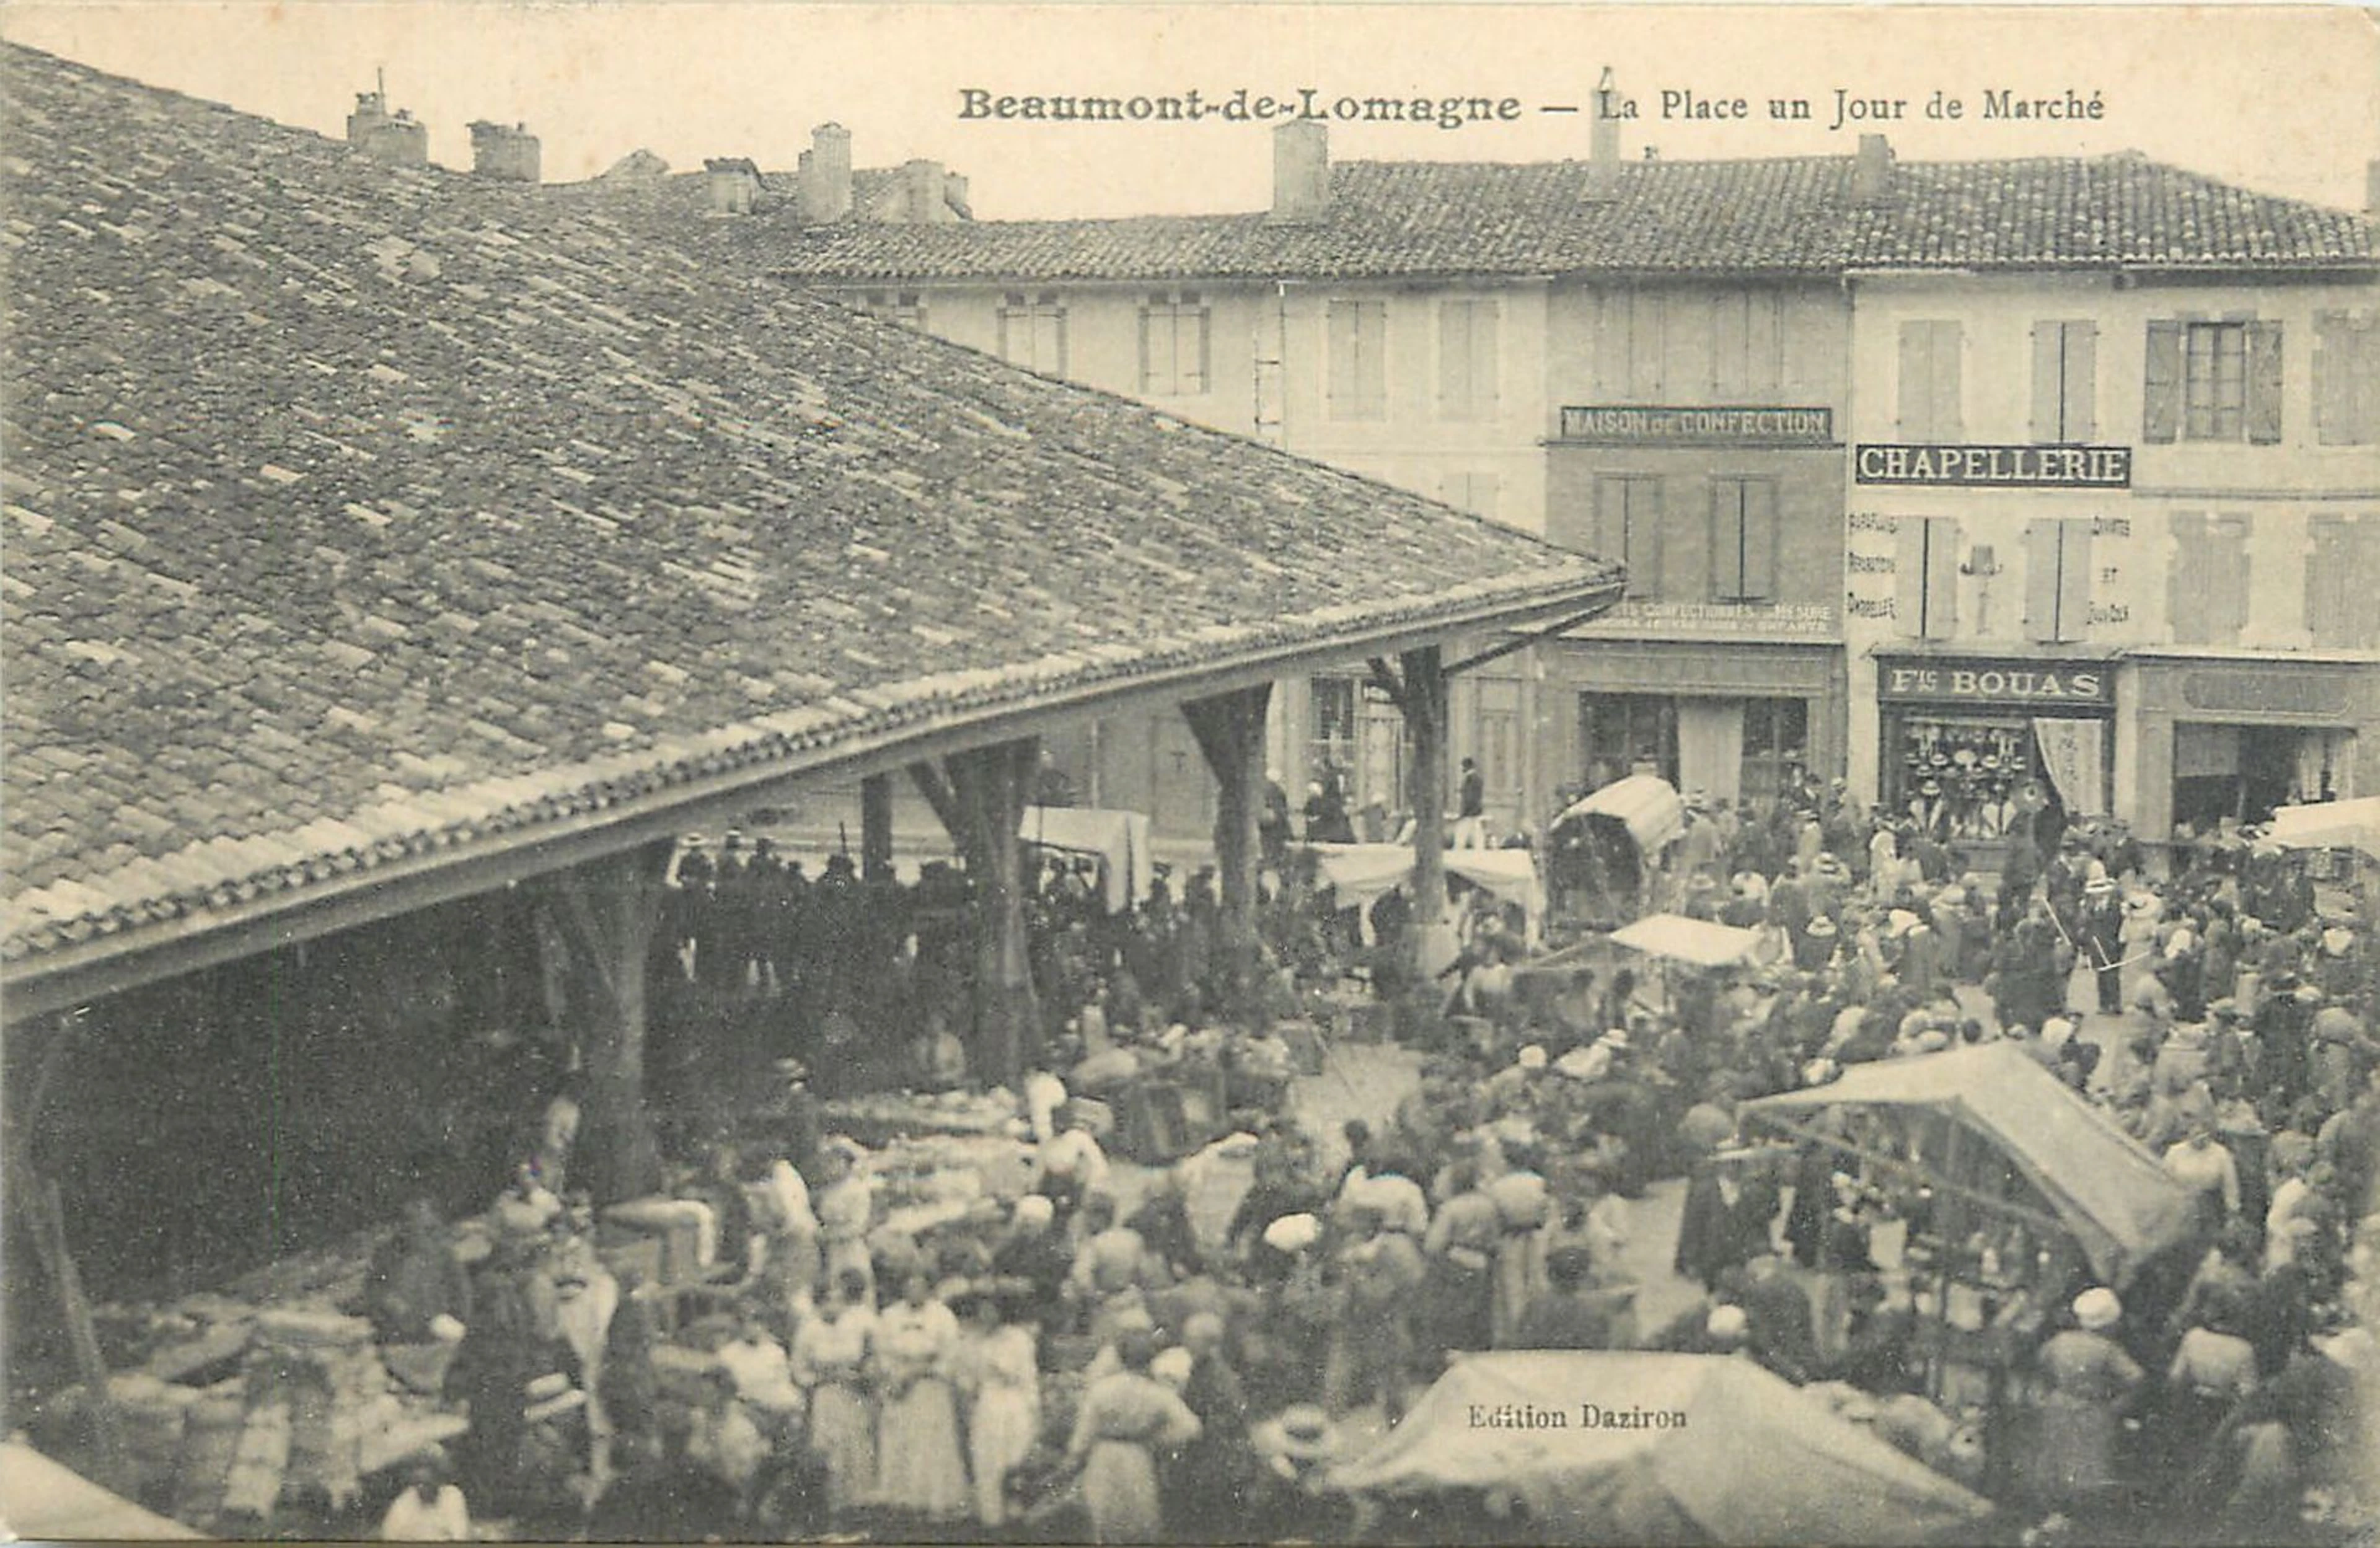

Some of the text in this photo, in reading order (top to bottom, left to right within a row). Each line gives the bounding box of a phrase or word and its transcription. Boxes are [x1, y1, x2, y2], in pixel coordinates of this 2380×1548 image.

[1565, 410, 1647, 434] MAISON
[1681, 410, 1825, 434] CONFECTION
[1860, 448, 2126, 481] CHAPELLERIE
[1952, 671, 2100, 697] BOUAS
